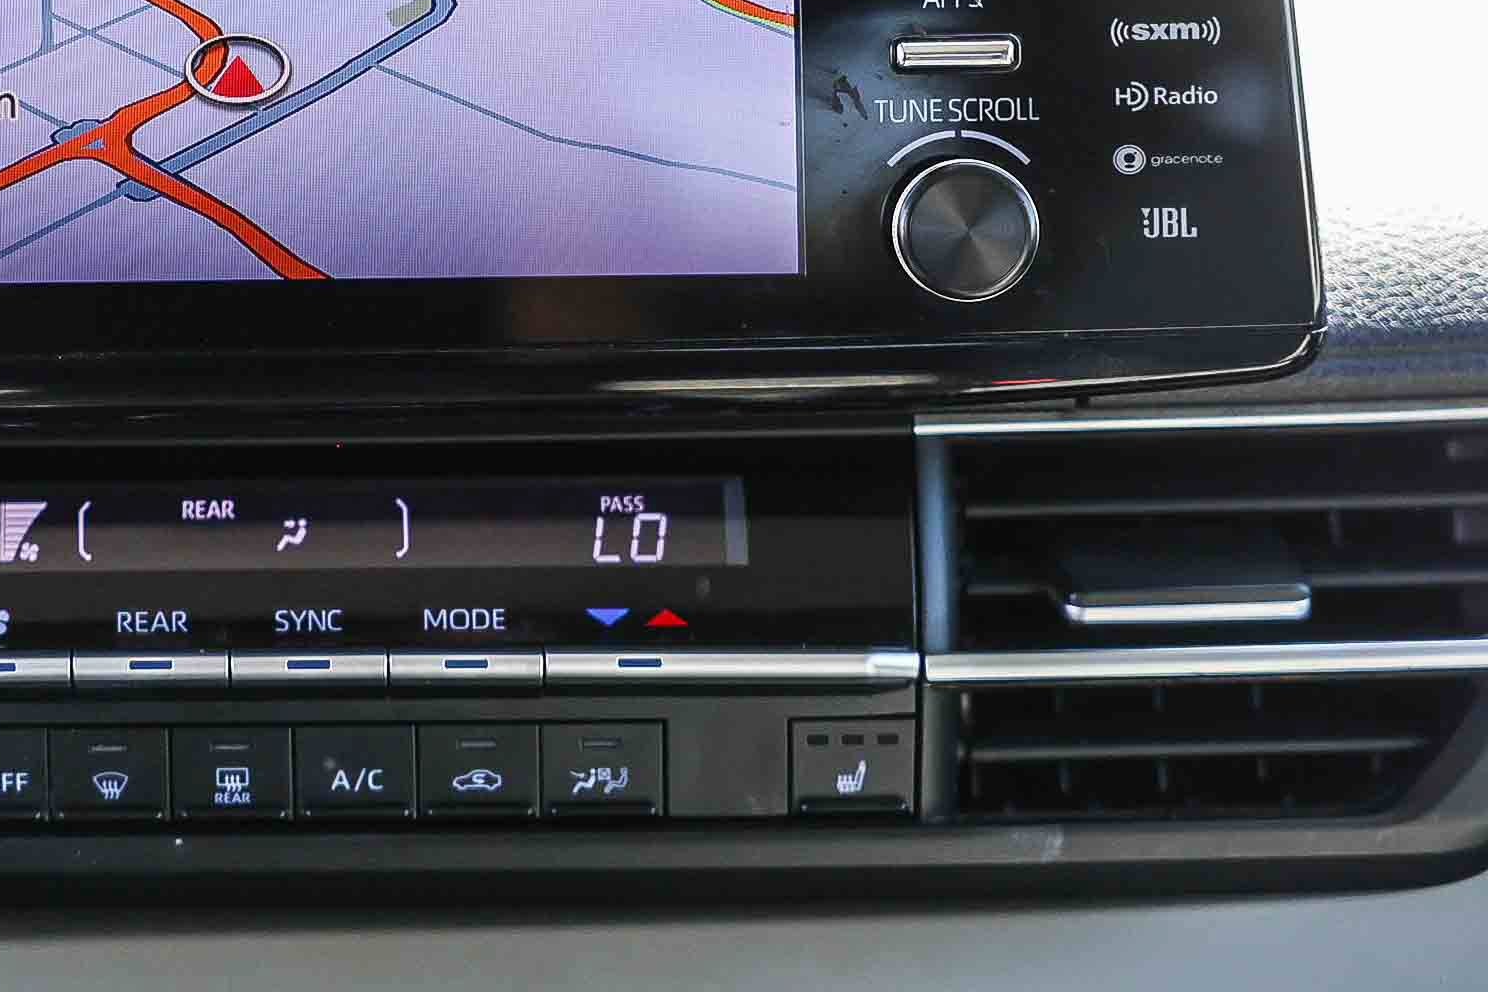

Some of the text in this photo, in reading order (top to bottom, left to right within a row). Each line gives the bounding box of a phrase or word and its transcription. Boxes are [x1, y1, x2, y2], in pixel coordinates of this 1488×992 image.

[1153, 84, 1219, 105] Radio
[873, 97, 1040, 124] TUNE SCROLL
[1150, 154, 1224, 168] gracenote
[1140, 207, 1198, 239] JBL
[181, 499, 235, 520] REAR
[600, 495, 644, 513] PASS
[117, 610, 188, 633] REAR
[275, 608, 342, 632] SYNC
[423, 608, 505, 630] MODE
[331, 767, 383, 792] A/C
[214, 787, 251, 804] REAR
